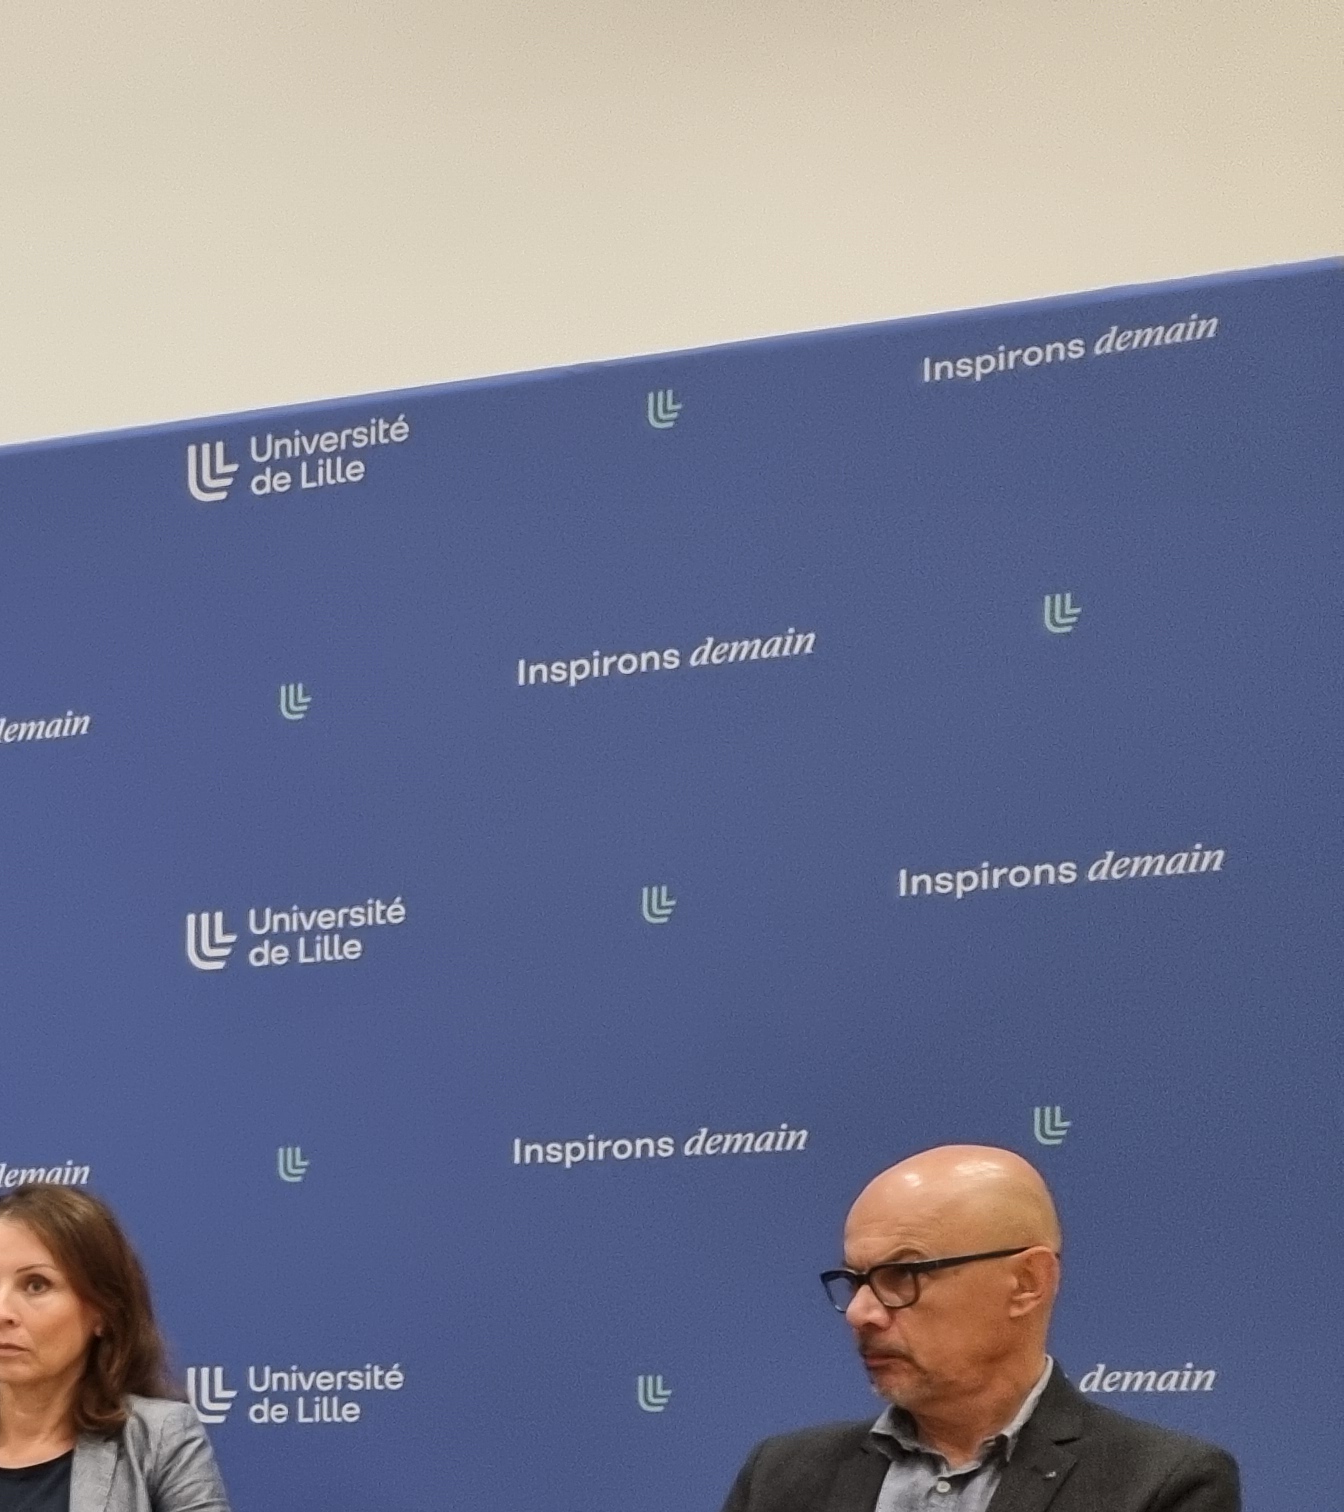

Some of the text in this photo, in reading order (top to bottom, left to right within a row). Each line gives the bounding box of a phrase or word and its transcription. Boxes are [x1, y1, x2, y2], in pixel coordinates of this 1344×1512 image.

[923, 313, 1219, 383] Inspirons demain
[250, 414, 410, 463] Université
[249, 455, 366, 496] de Lille
[517, 627, 816, 687] Inspirons demain
[898, 842, 1225, 900] Inspirons demain
[248, 896, 406, 935] Université
[248, 933, 363, 967] de Lille
[513, 1122, 809, 1169] Inspirons demain
[248, 1362, 405, 1393] Université
[1078, 1361, 1217, 1394] demain
[248, 1395, 361, 1424] de Lille
